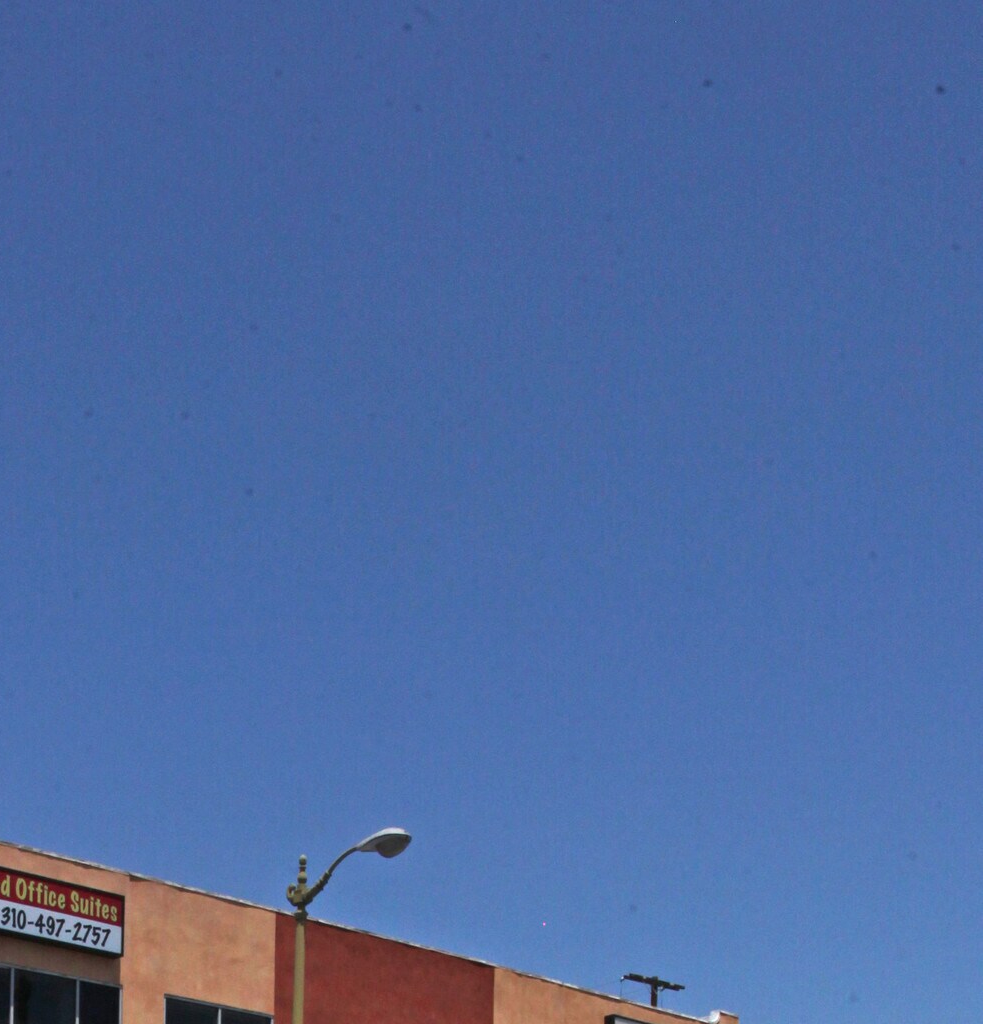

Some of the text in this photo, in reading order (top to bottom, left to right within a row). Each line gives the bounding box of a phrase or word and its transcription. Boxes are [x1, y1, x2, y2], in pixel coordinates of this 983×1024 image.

[15, 878, 66, 909] Office
[70, 890, 118, 922] Suites
[0, 906, 111, 947] 310-497-2757
